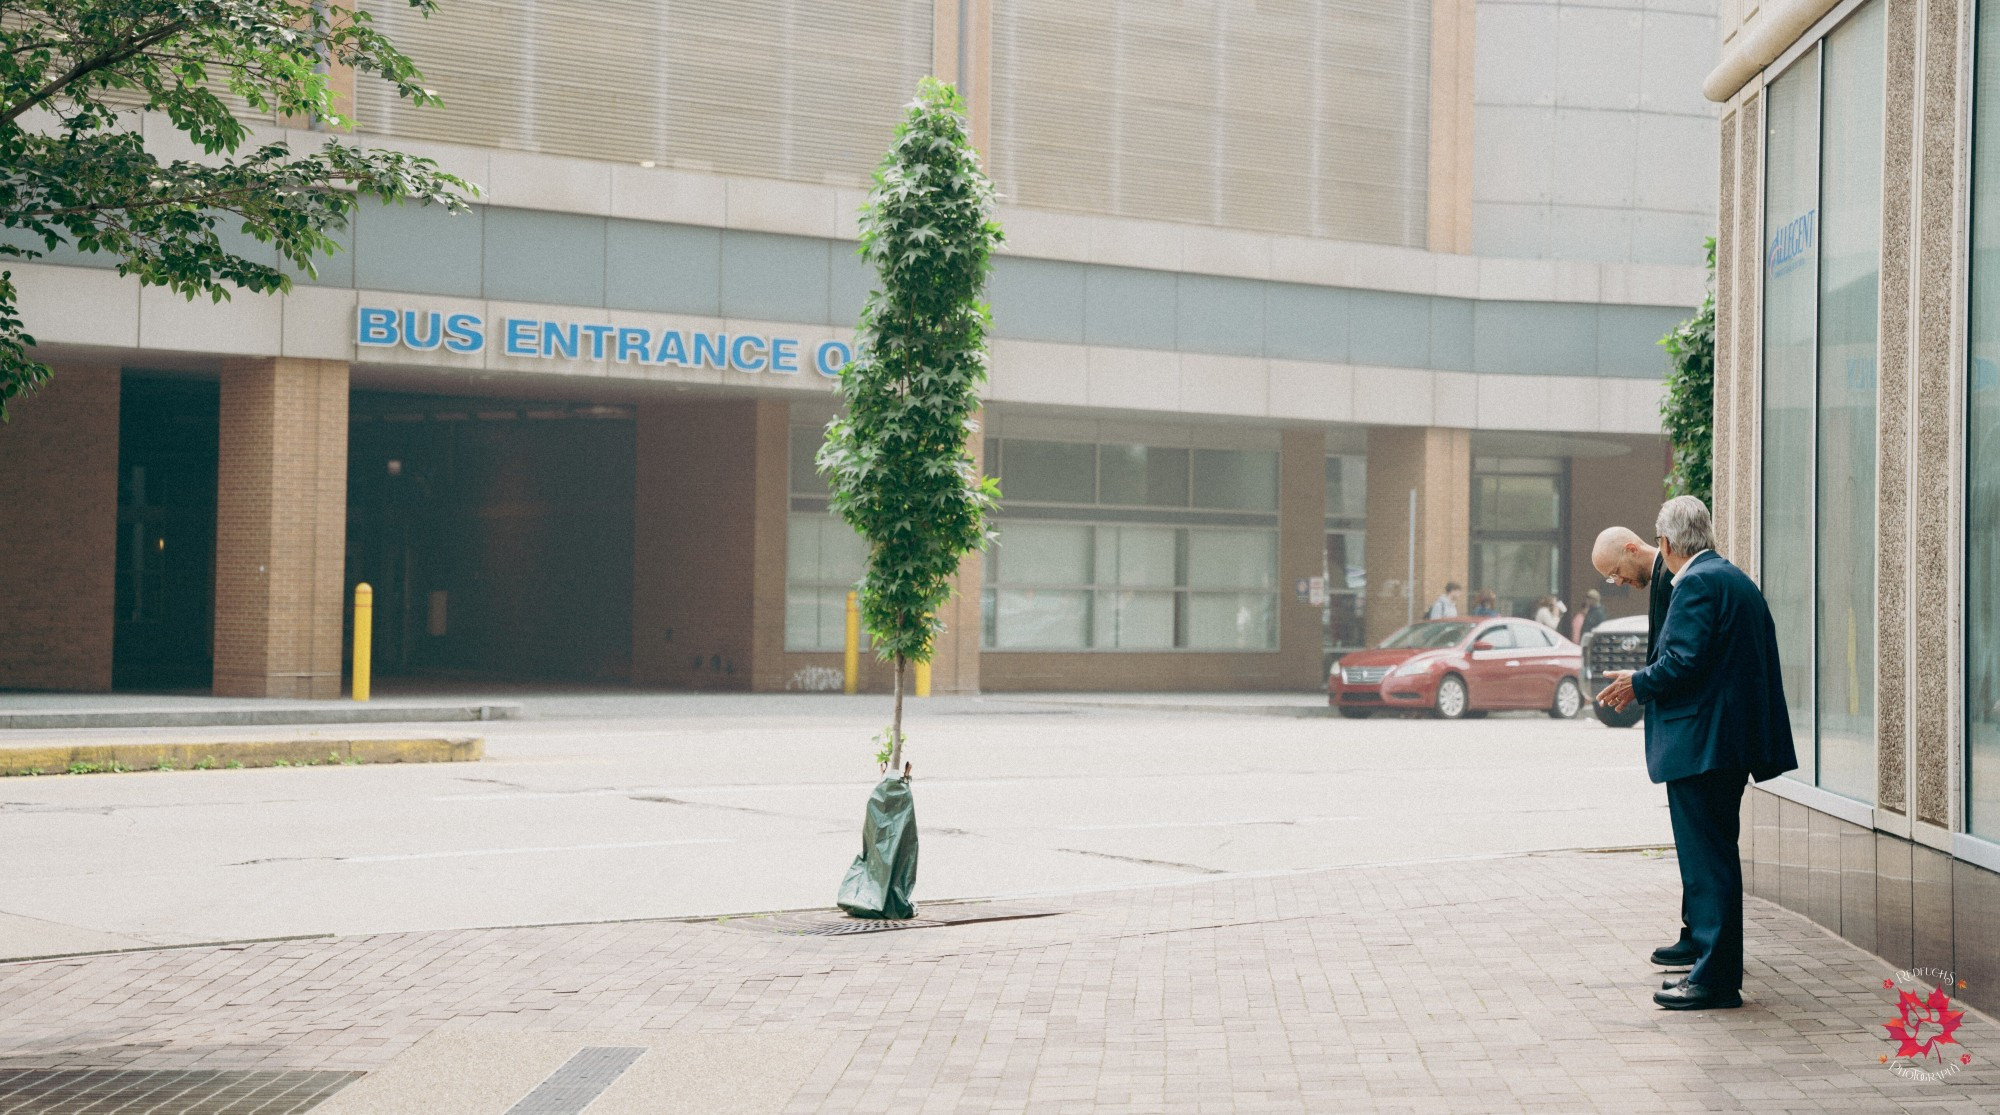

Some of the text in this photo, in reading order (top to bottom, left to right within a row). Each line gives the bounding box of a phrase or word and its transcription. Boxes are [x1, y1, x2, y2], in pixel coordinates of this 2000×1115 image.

[1768, 208, 1815, 268] ALLEGENT
[357, 306, 866, 378] BUS ENTRANCE O
